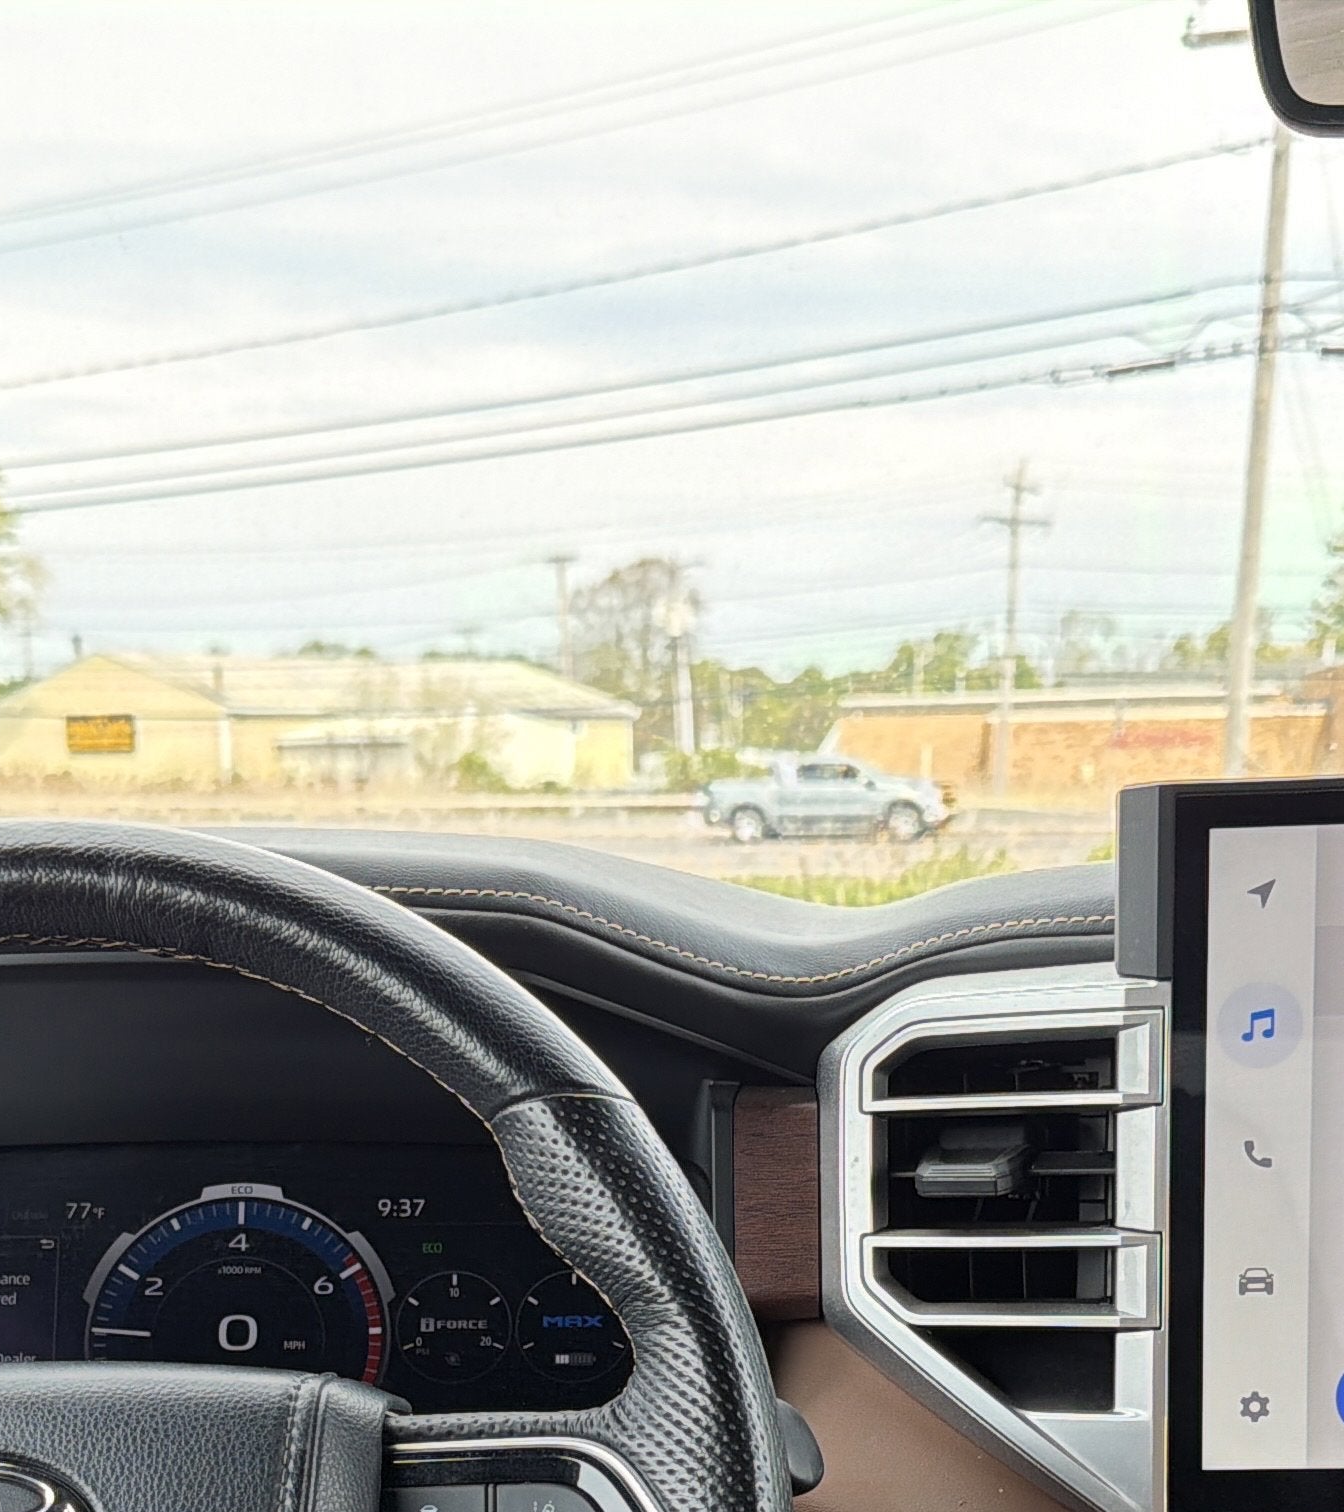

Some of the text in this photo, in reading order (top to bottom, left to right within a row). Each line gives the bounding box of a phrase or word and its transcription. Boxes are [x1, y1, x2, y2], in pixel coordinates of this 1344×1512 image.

[230, 1185, 254, 1195] ECO
[377, 1199, 426, 1217] 9:37
[228, 1233, 250, 1251] 4
[422, 1243, 443, 1254] ECO
[144, 1277, 165, 1296] 2
[313, 1276, 334, 1295] 6
[448, 1287, 460, 1298] 10
[543, 1315, 604, 1328] MAX
[218, 1314, 258, 1352] 0
[283, 1340, 306, 1350] MPH
[415, 1336, 423, 1347] 0
[479, 1336, 492, 1347] 20
